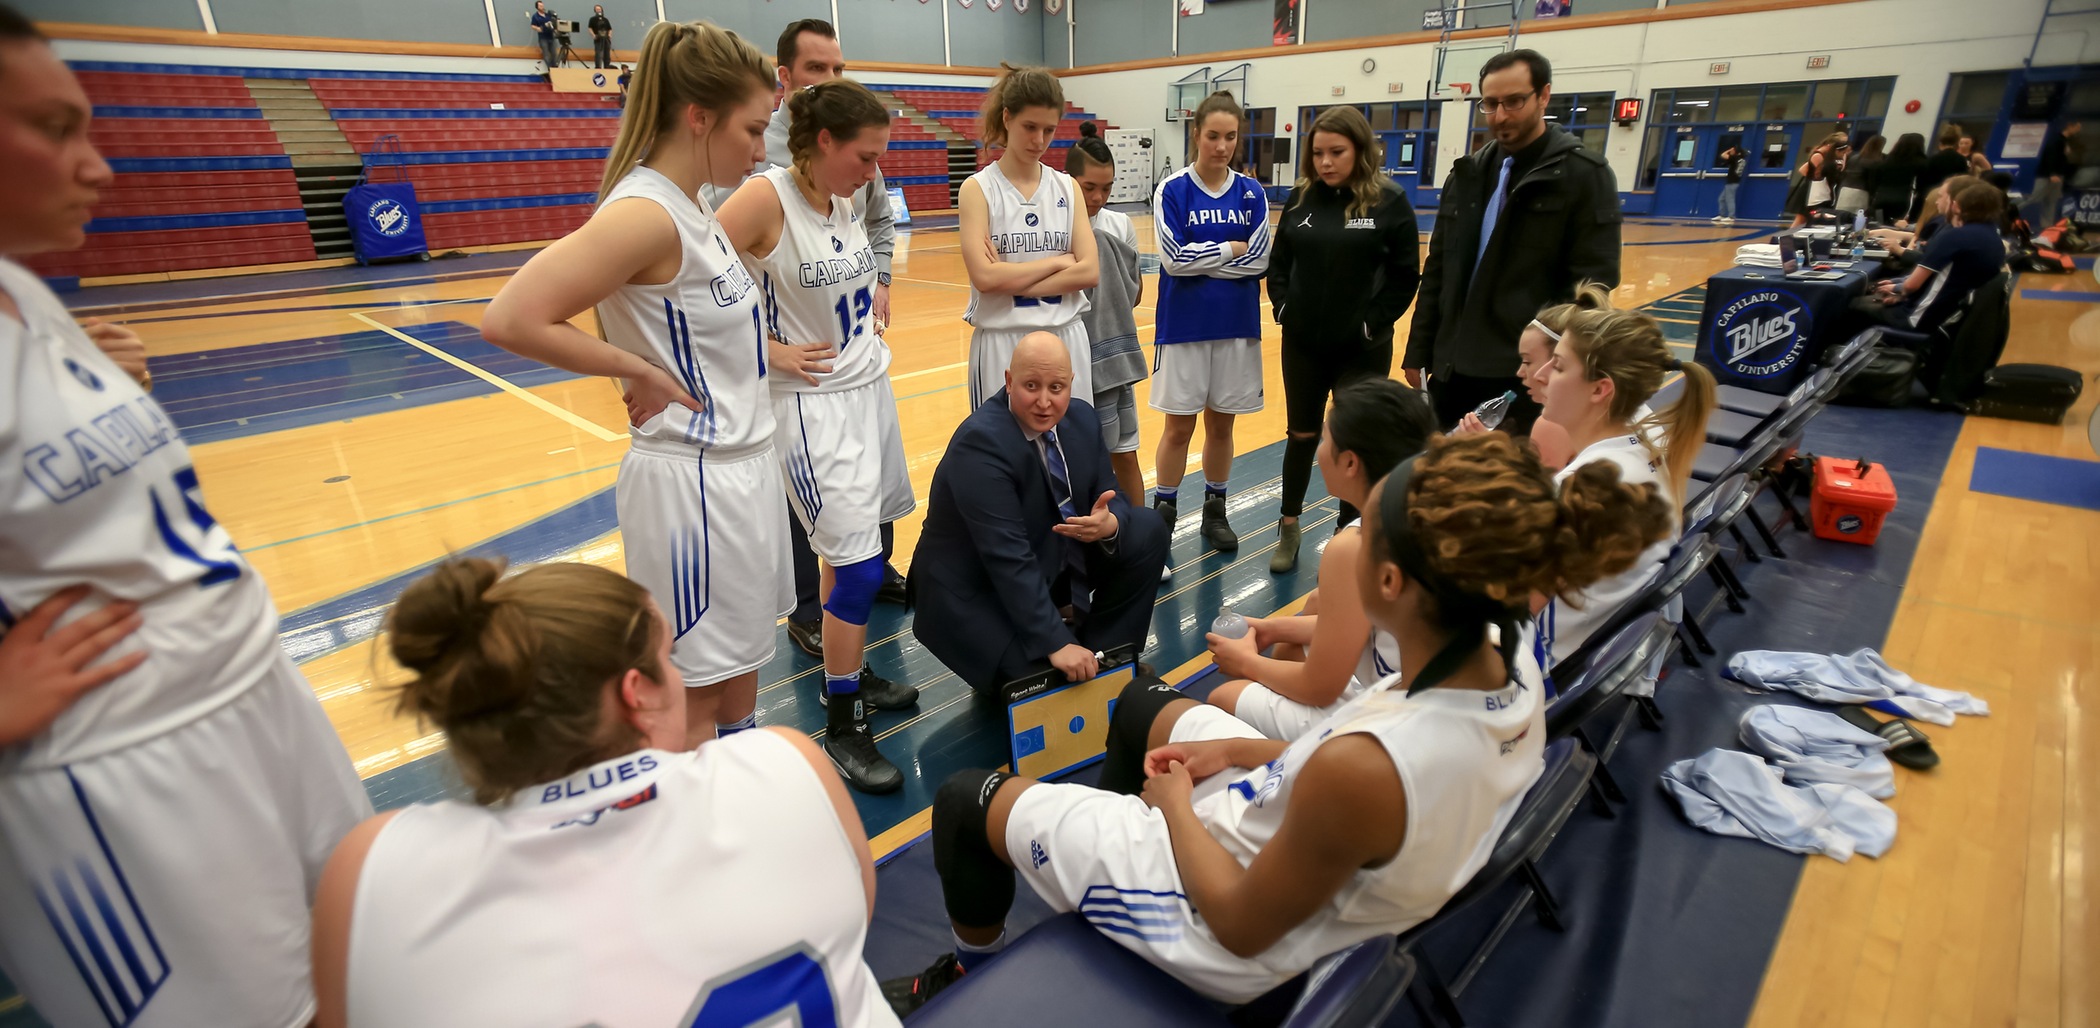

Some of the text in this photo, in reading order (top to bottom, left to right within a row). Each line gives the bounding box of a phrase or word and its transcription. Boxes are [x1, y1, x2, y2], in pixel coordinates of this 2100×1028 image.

[1619, 101, 1638, 118] 14
[375, 205, 402, 232] Blues
[2080, 194, 2100, 209] GO
[1718, 292, 1779, 327] CAPILANO
[1726, 307, 1801, 365] Blues
[1737, 335, 1808, 375] UNIVERSITY
[541, 755, 658, 804] BLUES
